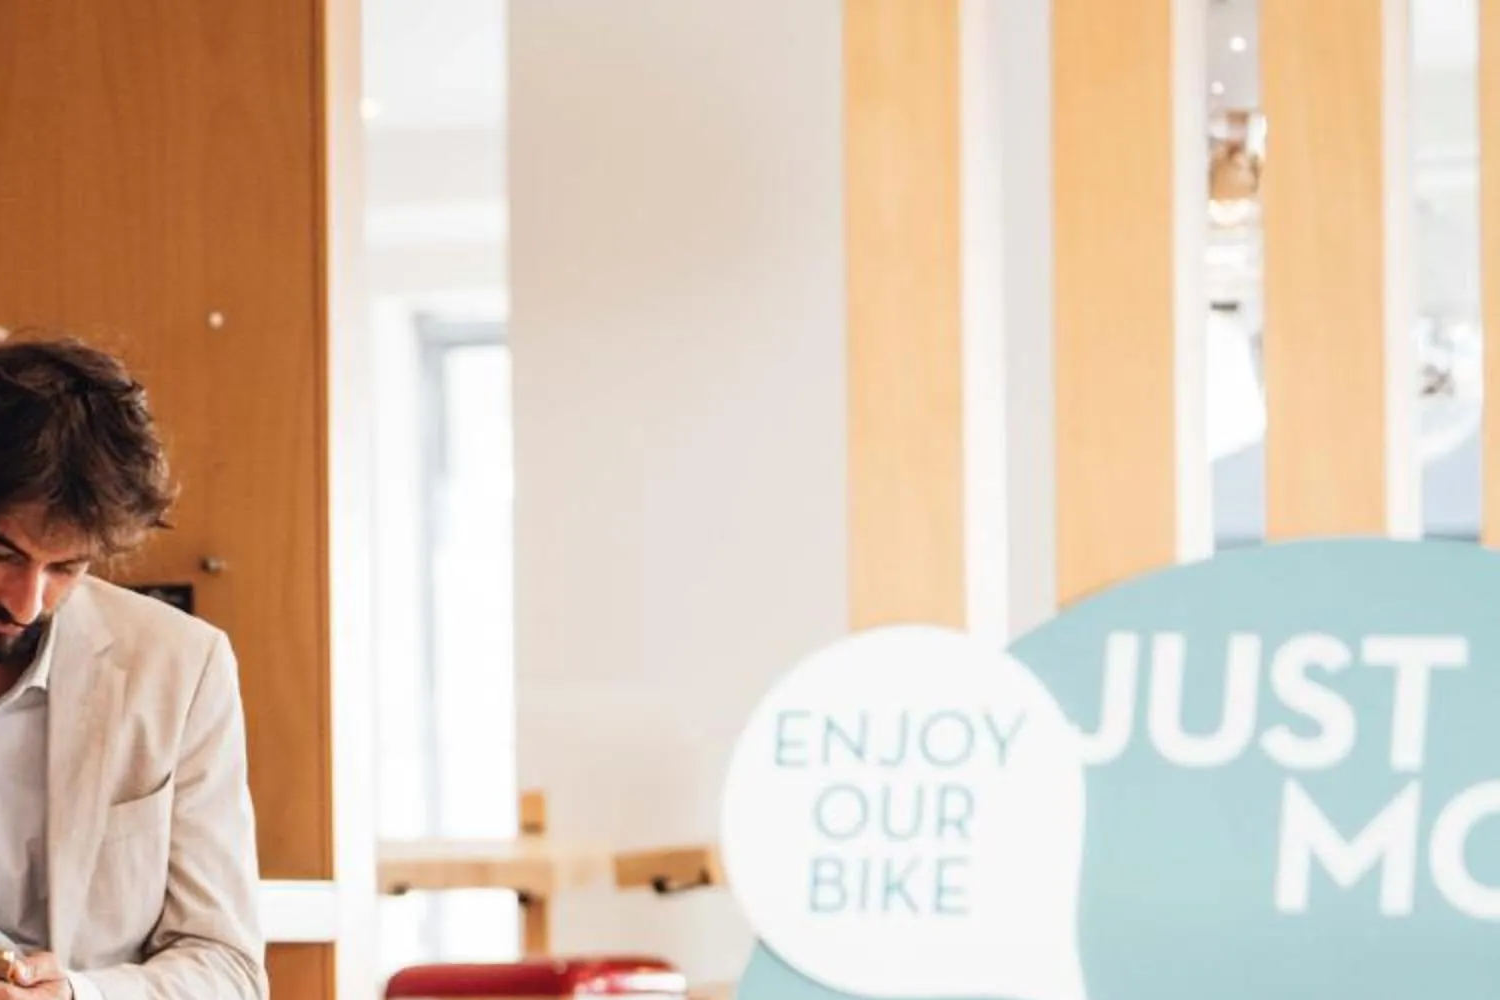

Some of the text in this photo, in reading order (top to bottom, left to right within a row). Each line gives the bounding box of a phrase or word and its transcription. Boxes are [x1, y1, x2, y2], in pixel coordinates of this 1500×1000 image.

[1076, 630, 1469, 773] JUST
[773, 708, 1027, 770] ENJOY
[812, 783, 976, 843] OUR
[807, 856, 970, 917] BIKE
